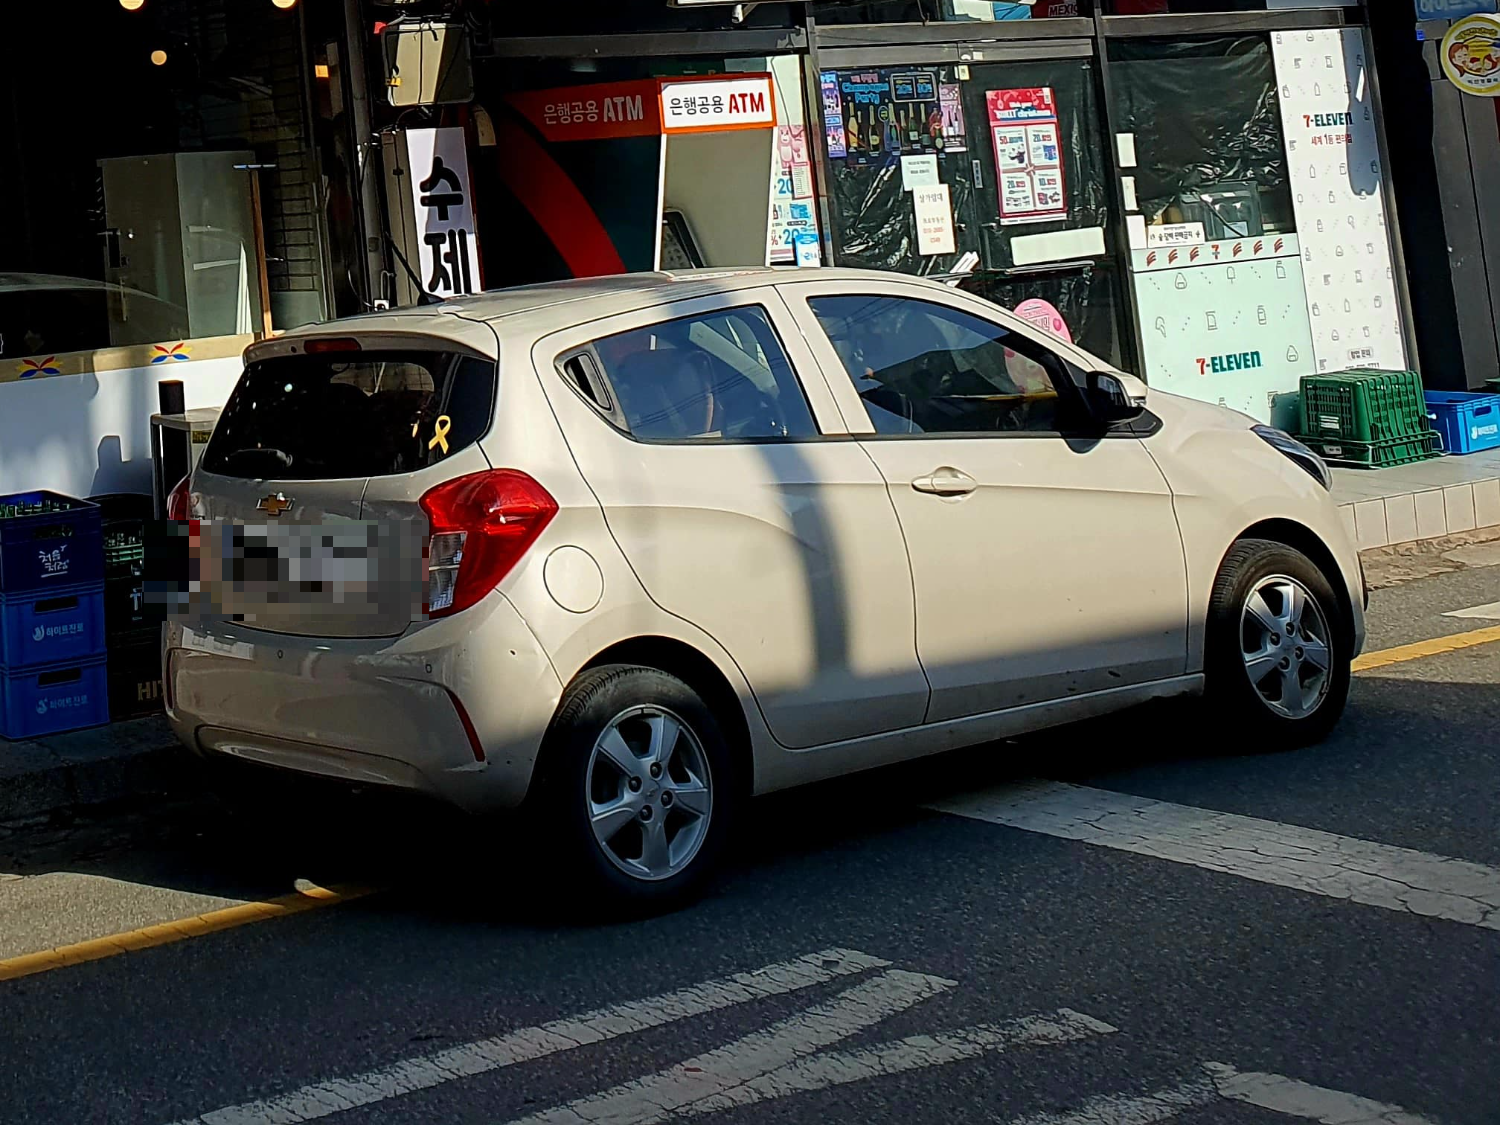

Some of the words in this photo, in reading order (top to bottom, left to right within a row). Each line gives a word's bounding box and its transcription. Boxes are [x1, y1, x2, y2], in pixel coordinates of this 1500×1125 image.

[544, 100, 599, 125] 은행공용
[603, 94, 644, 123] ATM
[669, 95, 724, 116] 은행공용
[728, 91, 766, 114] ATM
[919, 192, 943, 203] 상가임대
[420, 156, 474, 295] 수제
[46, 623, 84, 637] 하이트진로
